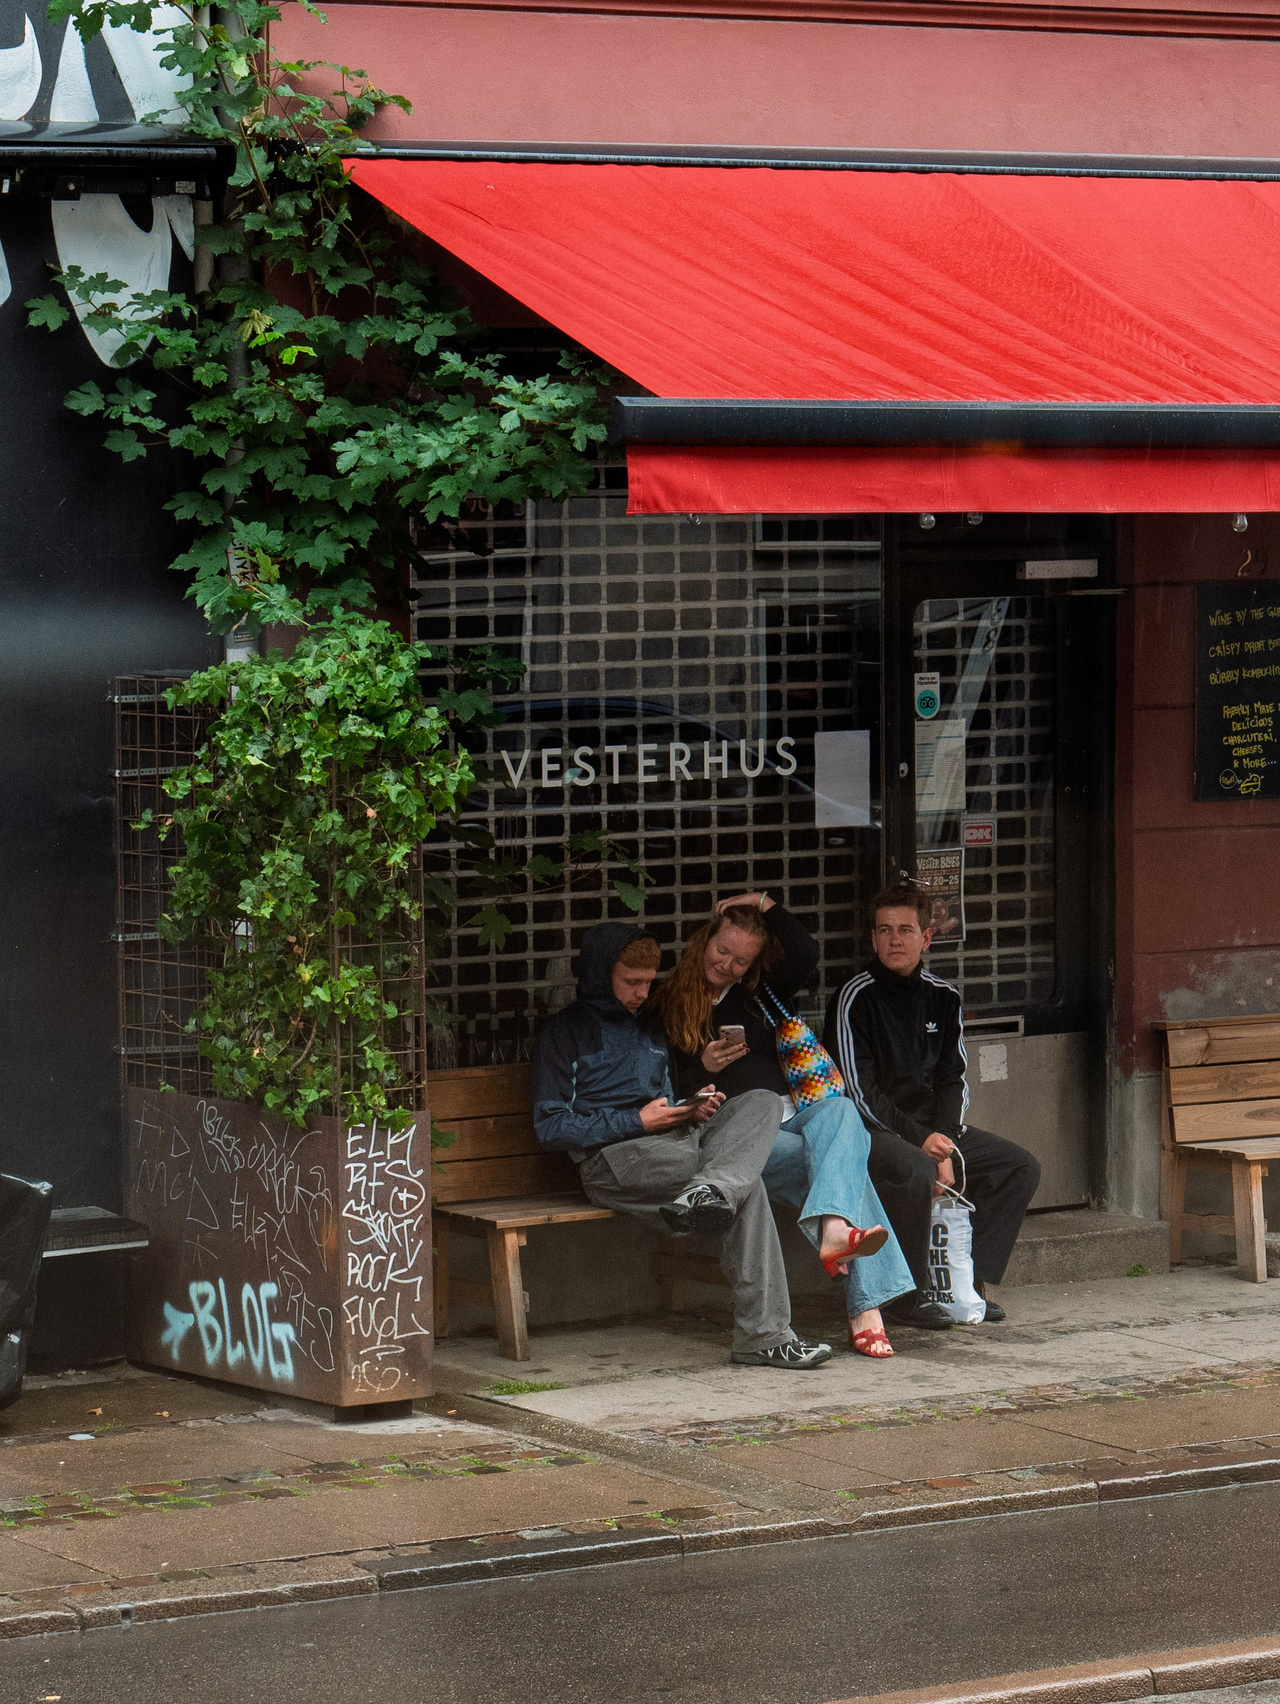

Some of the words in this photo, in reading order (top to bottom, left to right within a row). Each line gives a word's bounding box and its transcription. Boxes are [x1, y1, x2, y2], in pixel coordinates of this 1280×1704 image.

[1208, 609, 1233, 627] WINE
[1235, 608, 1247, 627] BY
[1250, 606, 1265, 620] THE
[1208, 639, 1241, 658] CRISPY
[1209, 668, 1240, 685] BUBBLY
[1253, 701, 1276, 715] MADE
[1231, 715, 1273, 731] DELICIOUS
[1232, 744, 1263, 757] CHEESES
[500, 736, 798, 790] VESTERHUS
[964, 827, 992, 841] DK
[916, 857, 940, 870] VESTER
[940, 855, 960, 869] BLUES
[933, 875, 959, 886] 20-25
[347, 1252, 424, 1302] ROCK
[188, 1277, 297, 1384] BLOG
